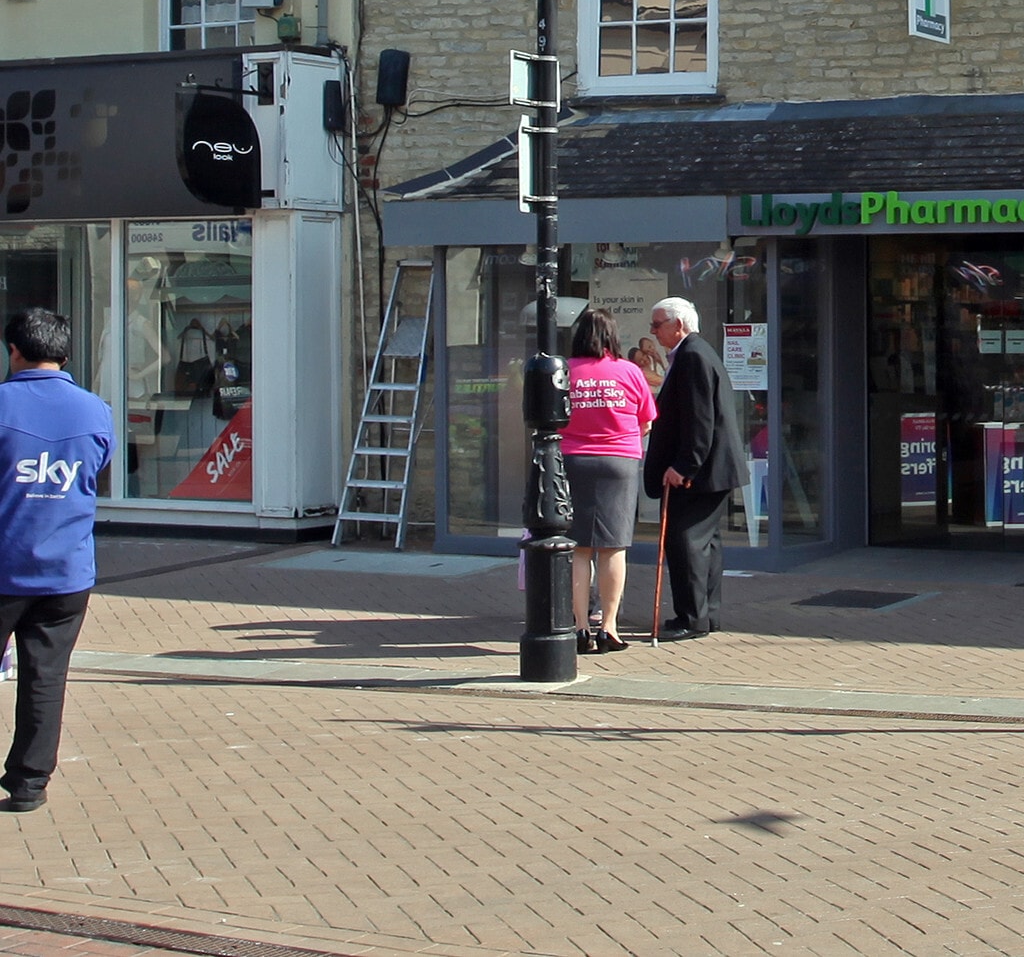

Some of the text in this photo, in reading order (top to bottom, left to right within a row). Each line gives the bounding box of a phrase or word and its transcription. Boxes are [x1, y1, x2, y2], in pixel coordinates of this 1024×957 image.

[916, 14, 945, 35] Pharmacy
[192, 140, 254, 155] new
[213, 153, 234, 161] look
[602, 297, 619, 305] your
[620, 295, 635, 303] skin
[637, 295, 644, 303] in
[613, 306, 621, 314] of
[576, 379, 597, 388] Ask
[570, 388, 624, 399] about Sky
[206, 432, 244, 483] SALE
[16, 452, 82, 491] sky
